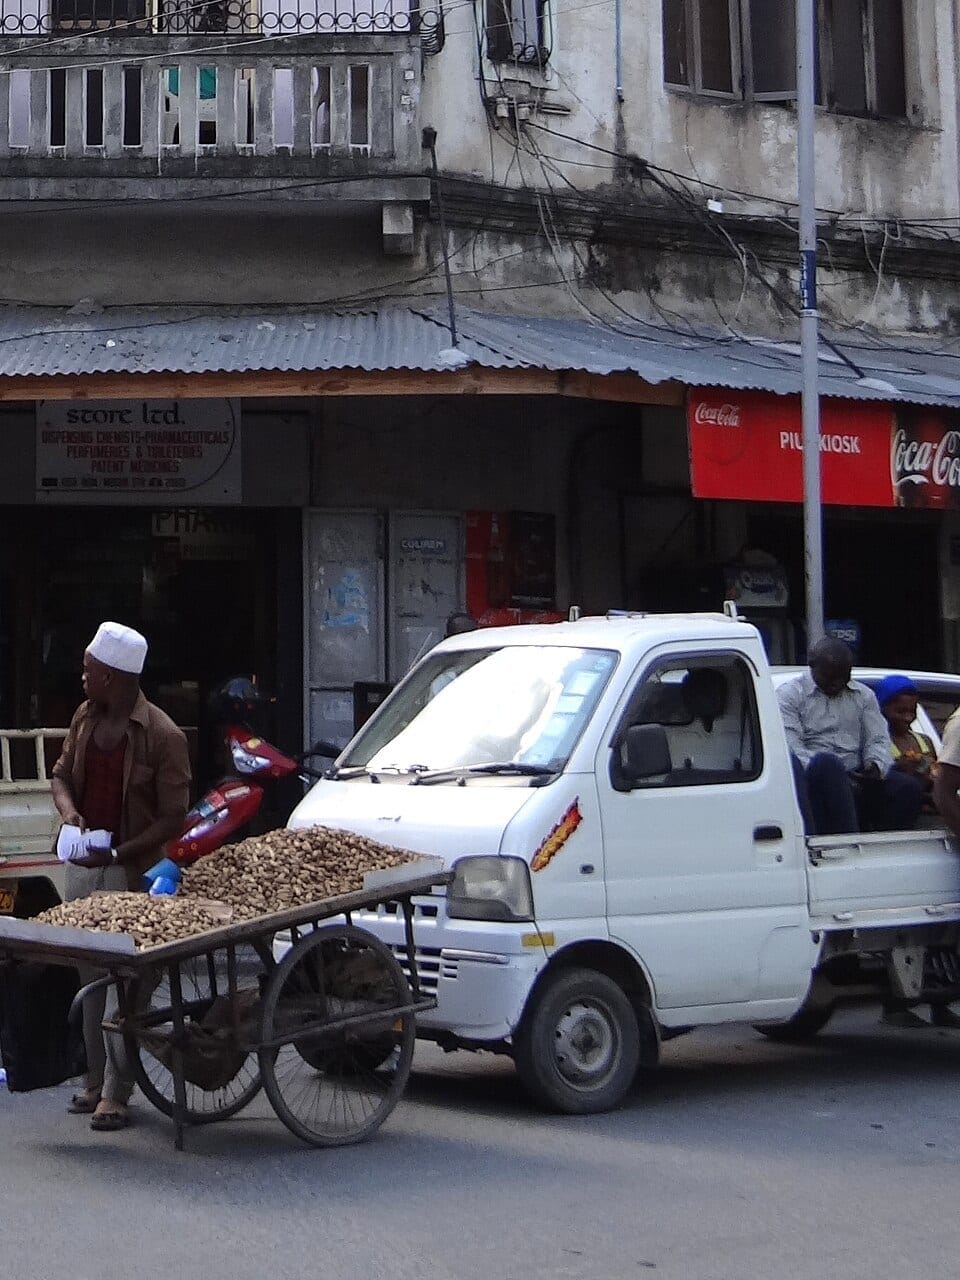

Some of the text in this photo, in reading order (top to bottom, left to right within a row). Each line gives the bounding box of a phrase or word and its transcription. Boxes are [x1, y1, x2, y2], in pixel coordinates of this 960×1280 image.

[67, 402, 186, 425] store ltd.
[695, 402, 740, 427] Coca-Cola
[817, 433, 861, 454] KIOSK
